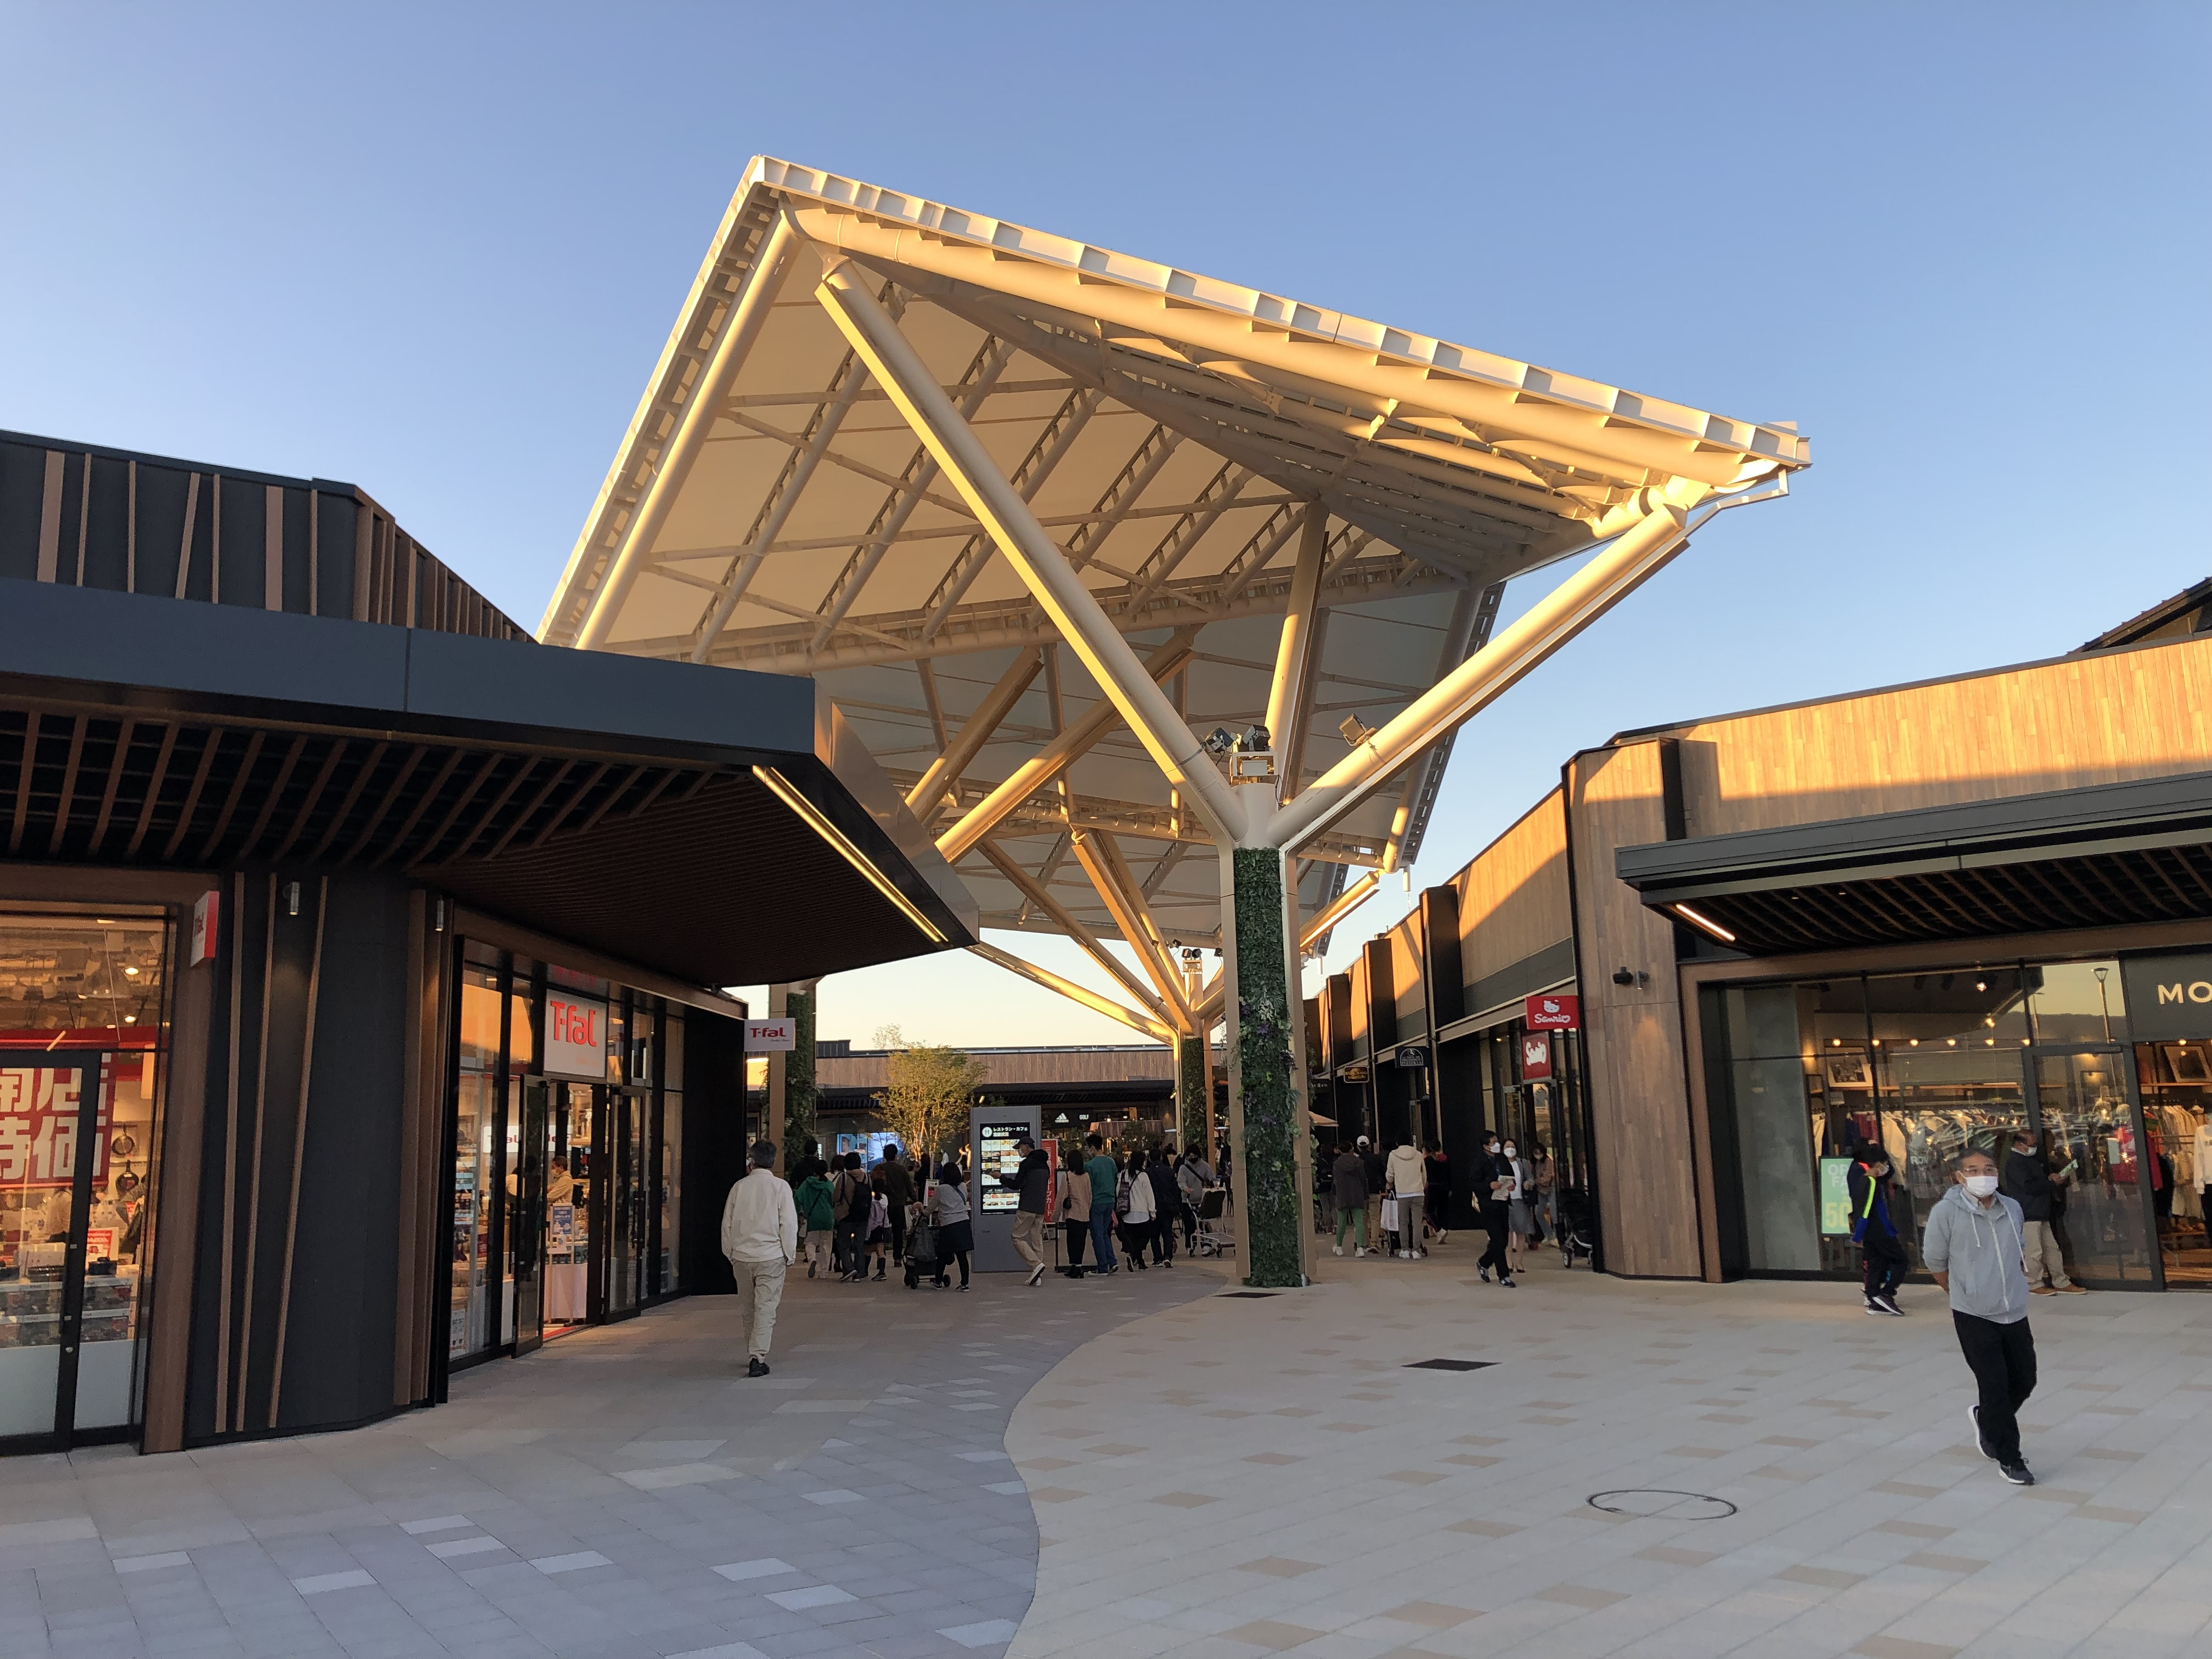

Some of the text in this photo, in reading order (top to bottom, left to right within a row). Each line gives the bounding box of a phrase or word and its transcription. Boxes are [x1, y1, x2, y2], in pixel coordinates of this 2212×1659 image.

[550, 1000, 597, 1047] T-fal
[1534, 1013, 1571, 1024] Sanrio
[749, 1027, 787, 1038] T-fal
